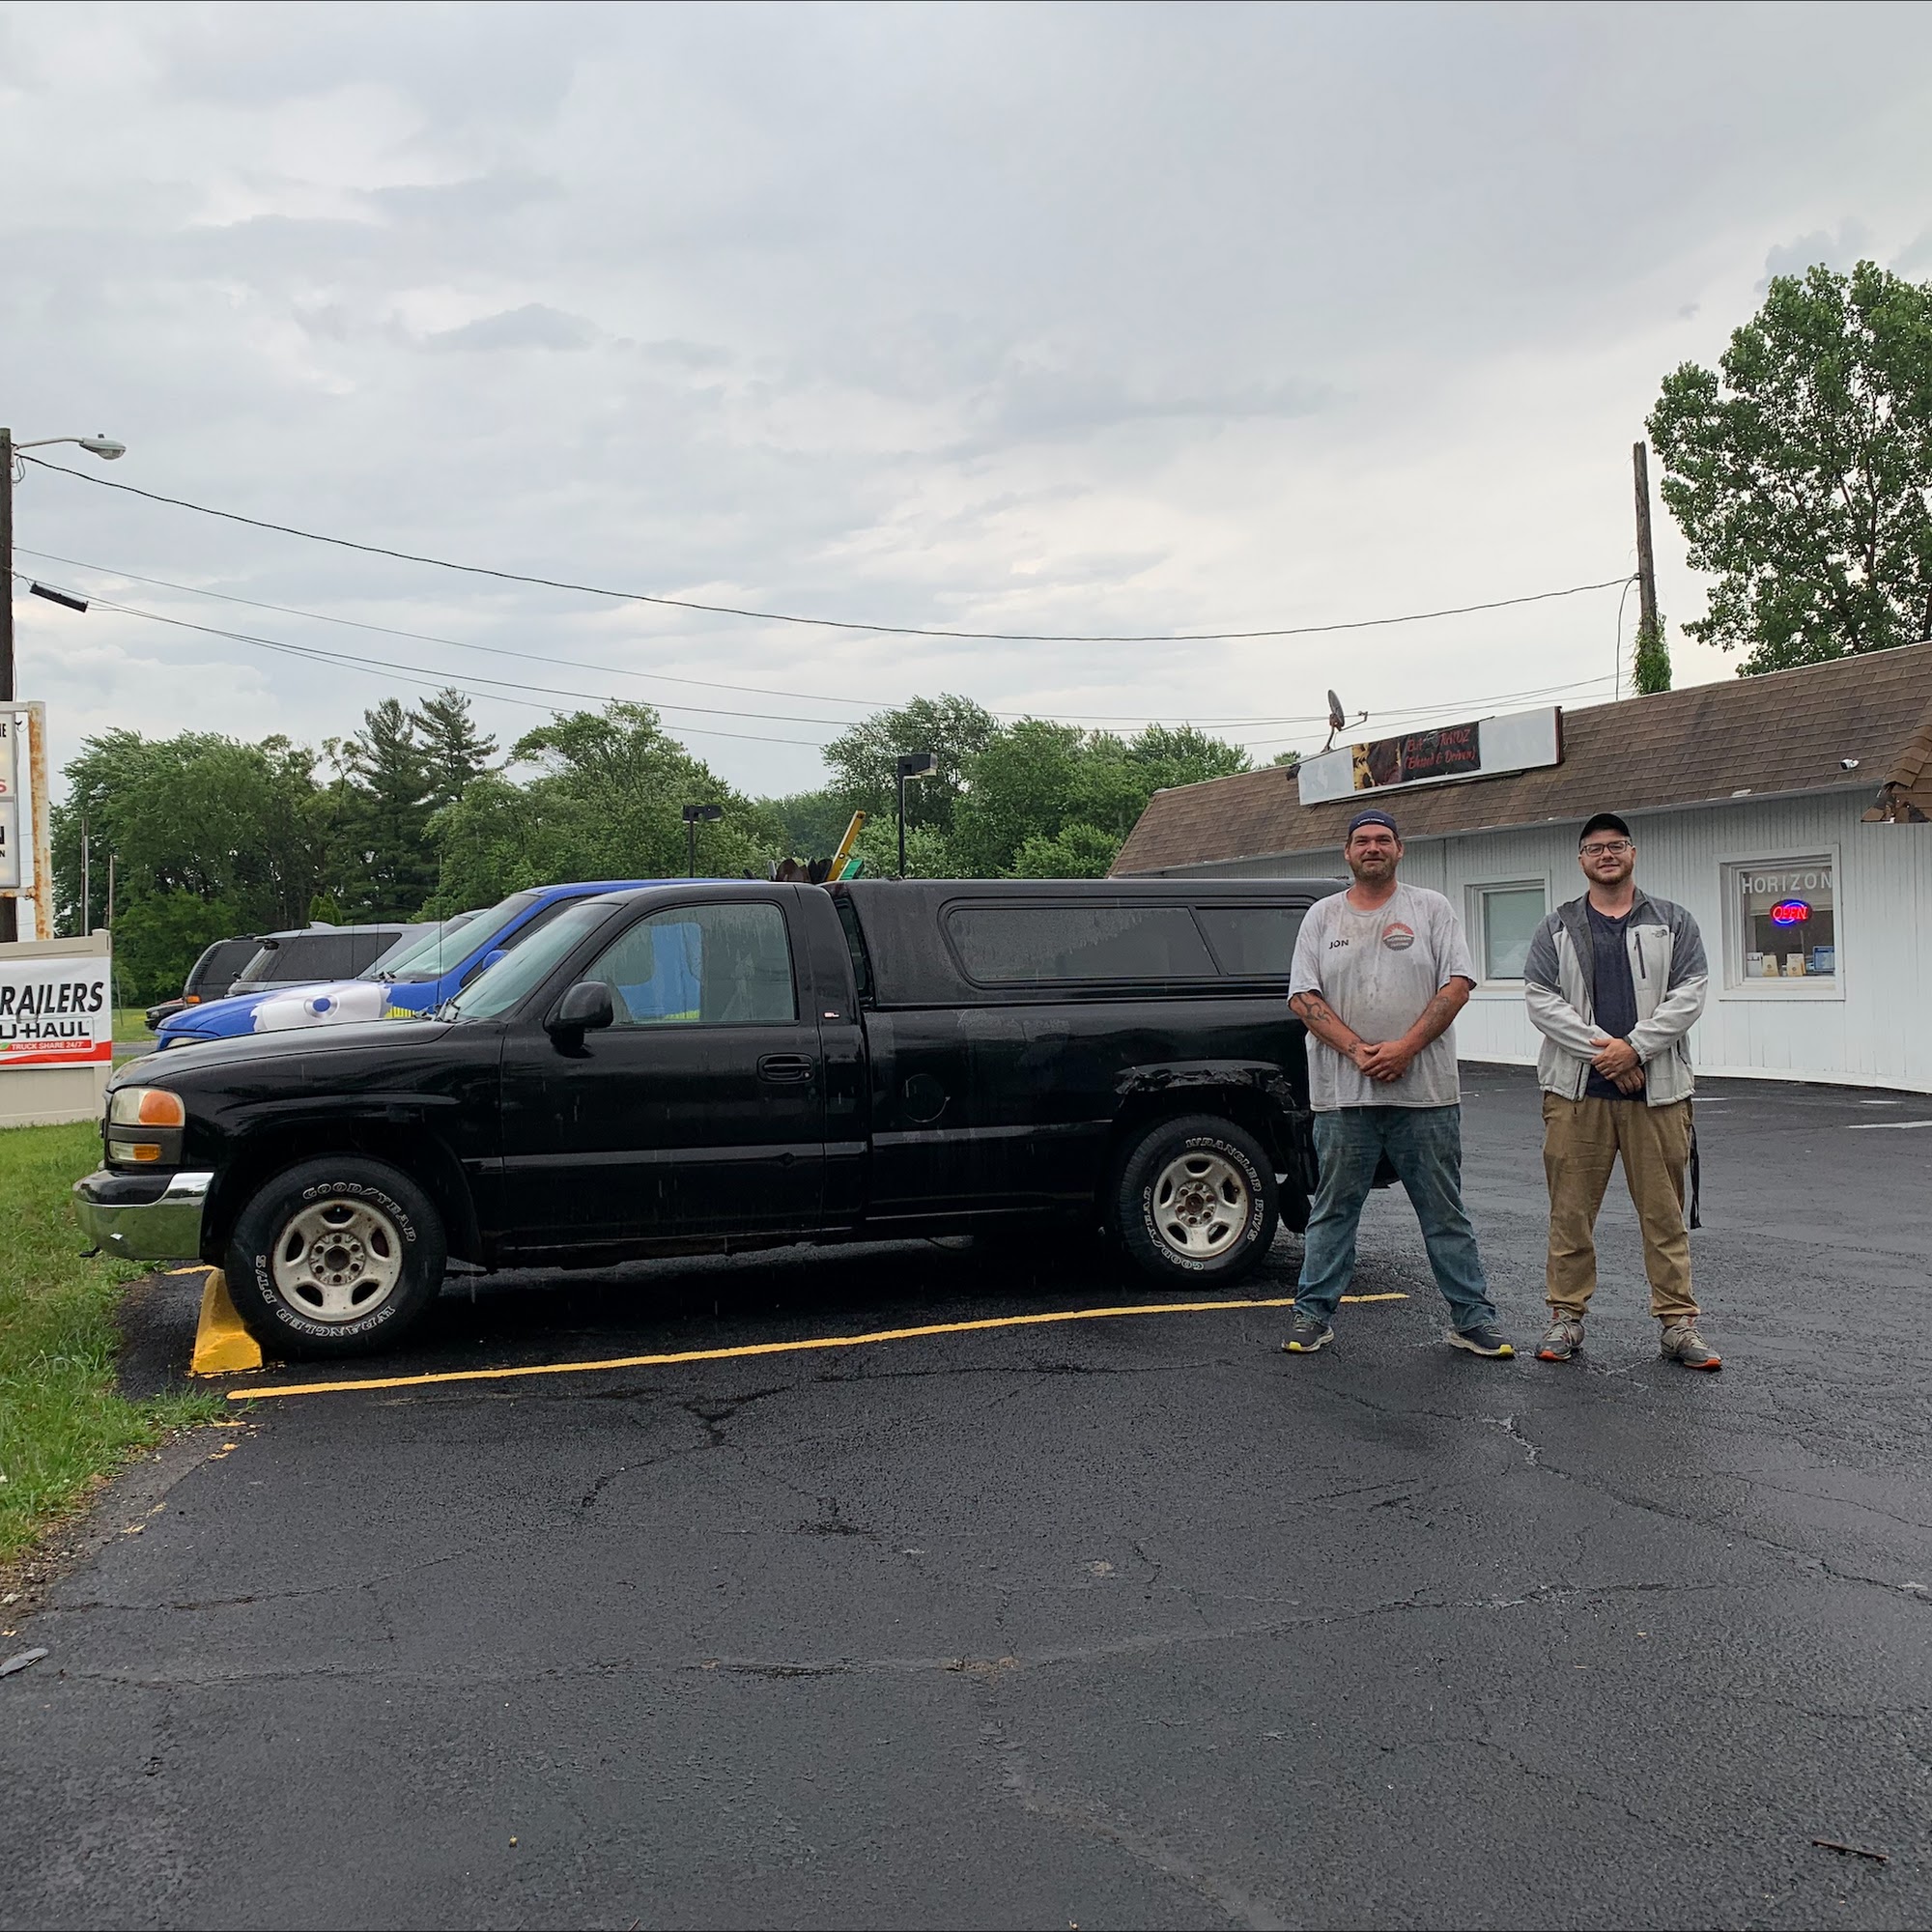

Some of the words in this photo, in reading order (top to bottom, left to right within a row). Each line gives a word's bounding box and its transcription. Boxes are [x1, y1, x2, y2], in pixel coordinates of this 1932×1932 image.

[1742, 870, 1833, 895] HORIZON
[1772, 905, 1809, 920] OPEN
[1328, 939, 1349, 950] JON
[0, 1021, 90, 1039] U-HAUL
[1185, 1137, 1262, 1192] WRANGLER
[275, 1305, 396, 1337] WRANGLER
